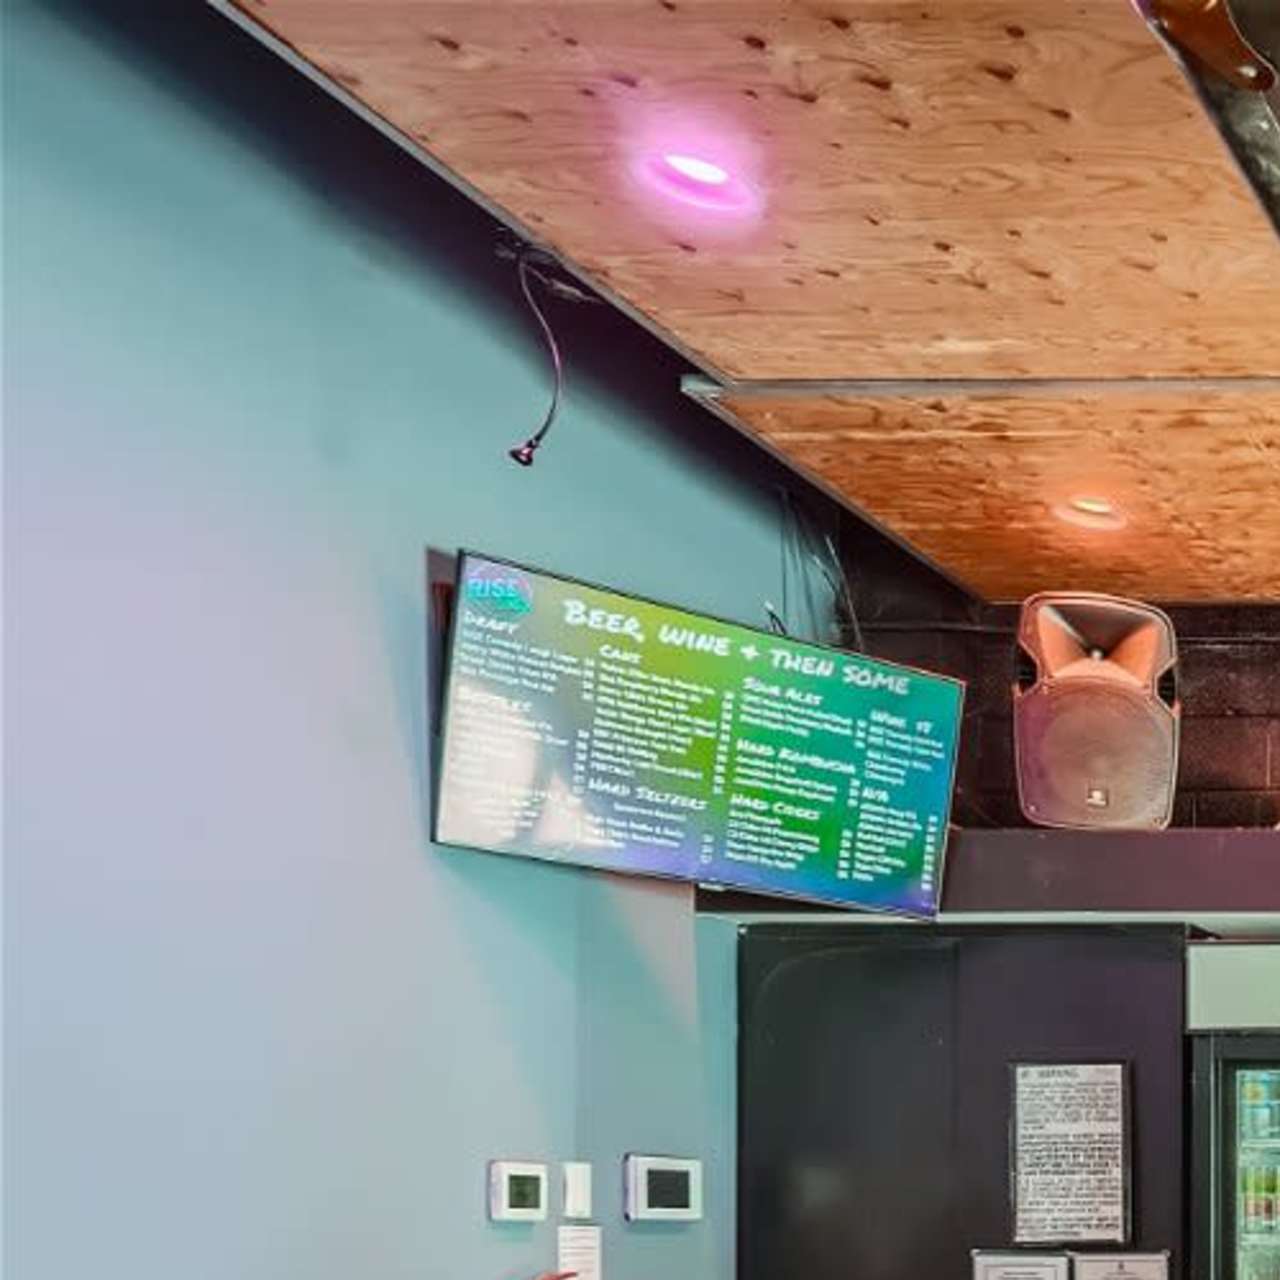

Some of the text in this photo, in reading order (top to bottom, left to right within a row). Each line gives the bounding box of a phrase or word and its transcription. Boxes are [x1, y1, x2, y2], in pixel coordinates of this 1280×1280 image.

[658, 624, 730, 657] WINE
[770, 649, 836, 678] THEN
[842, 665, 911, 696] SOME
